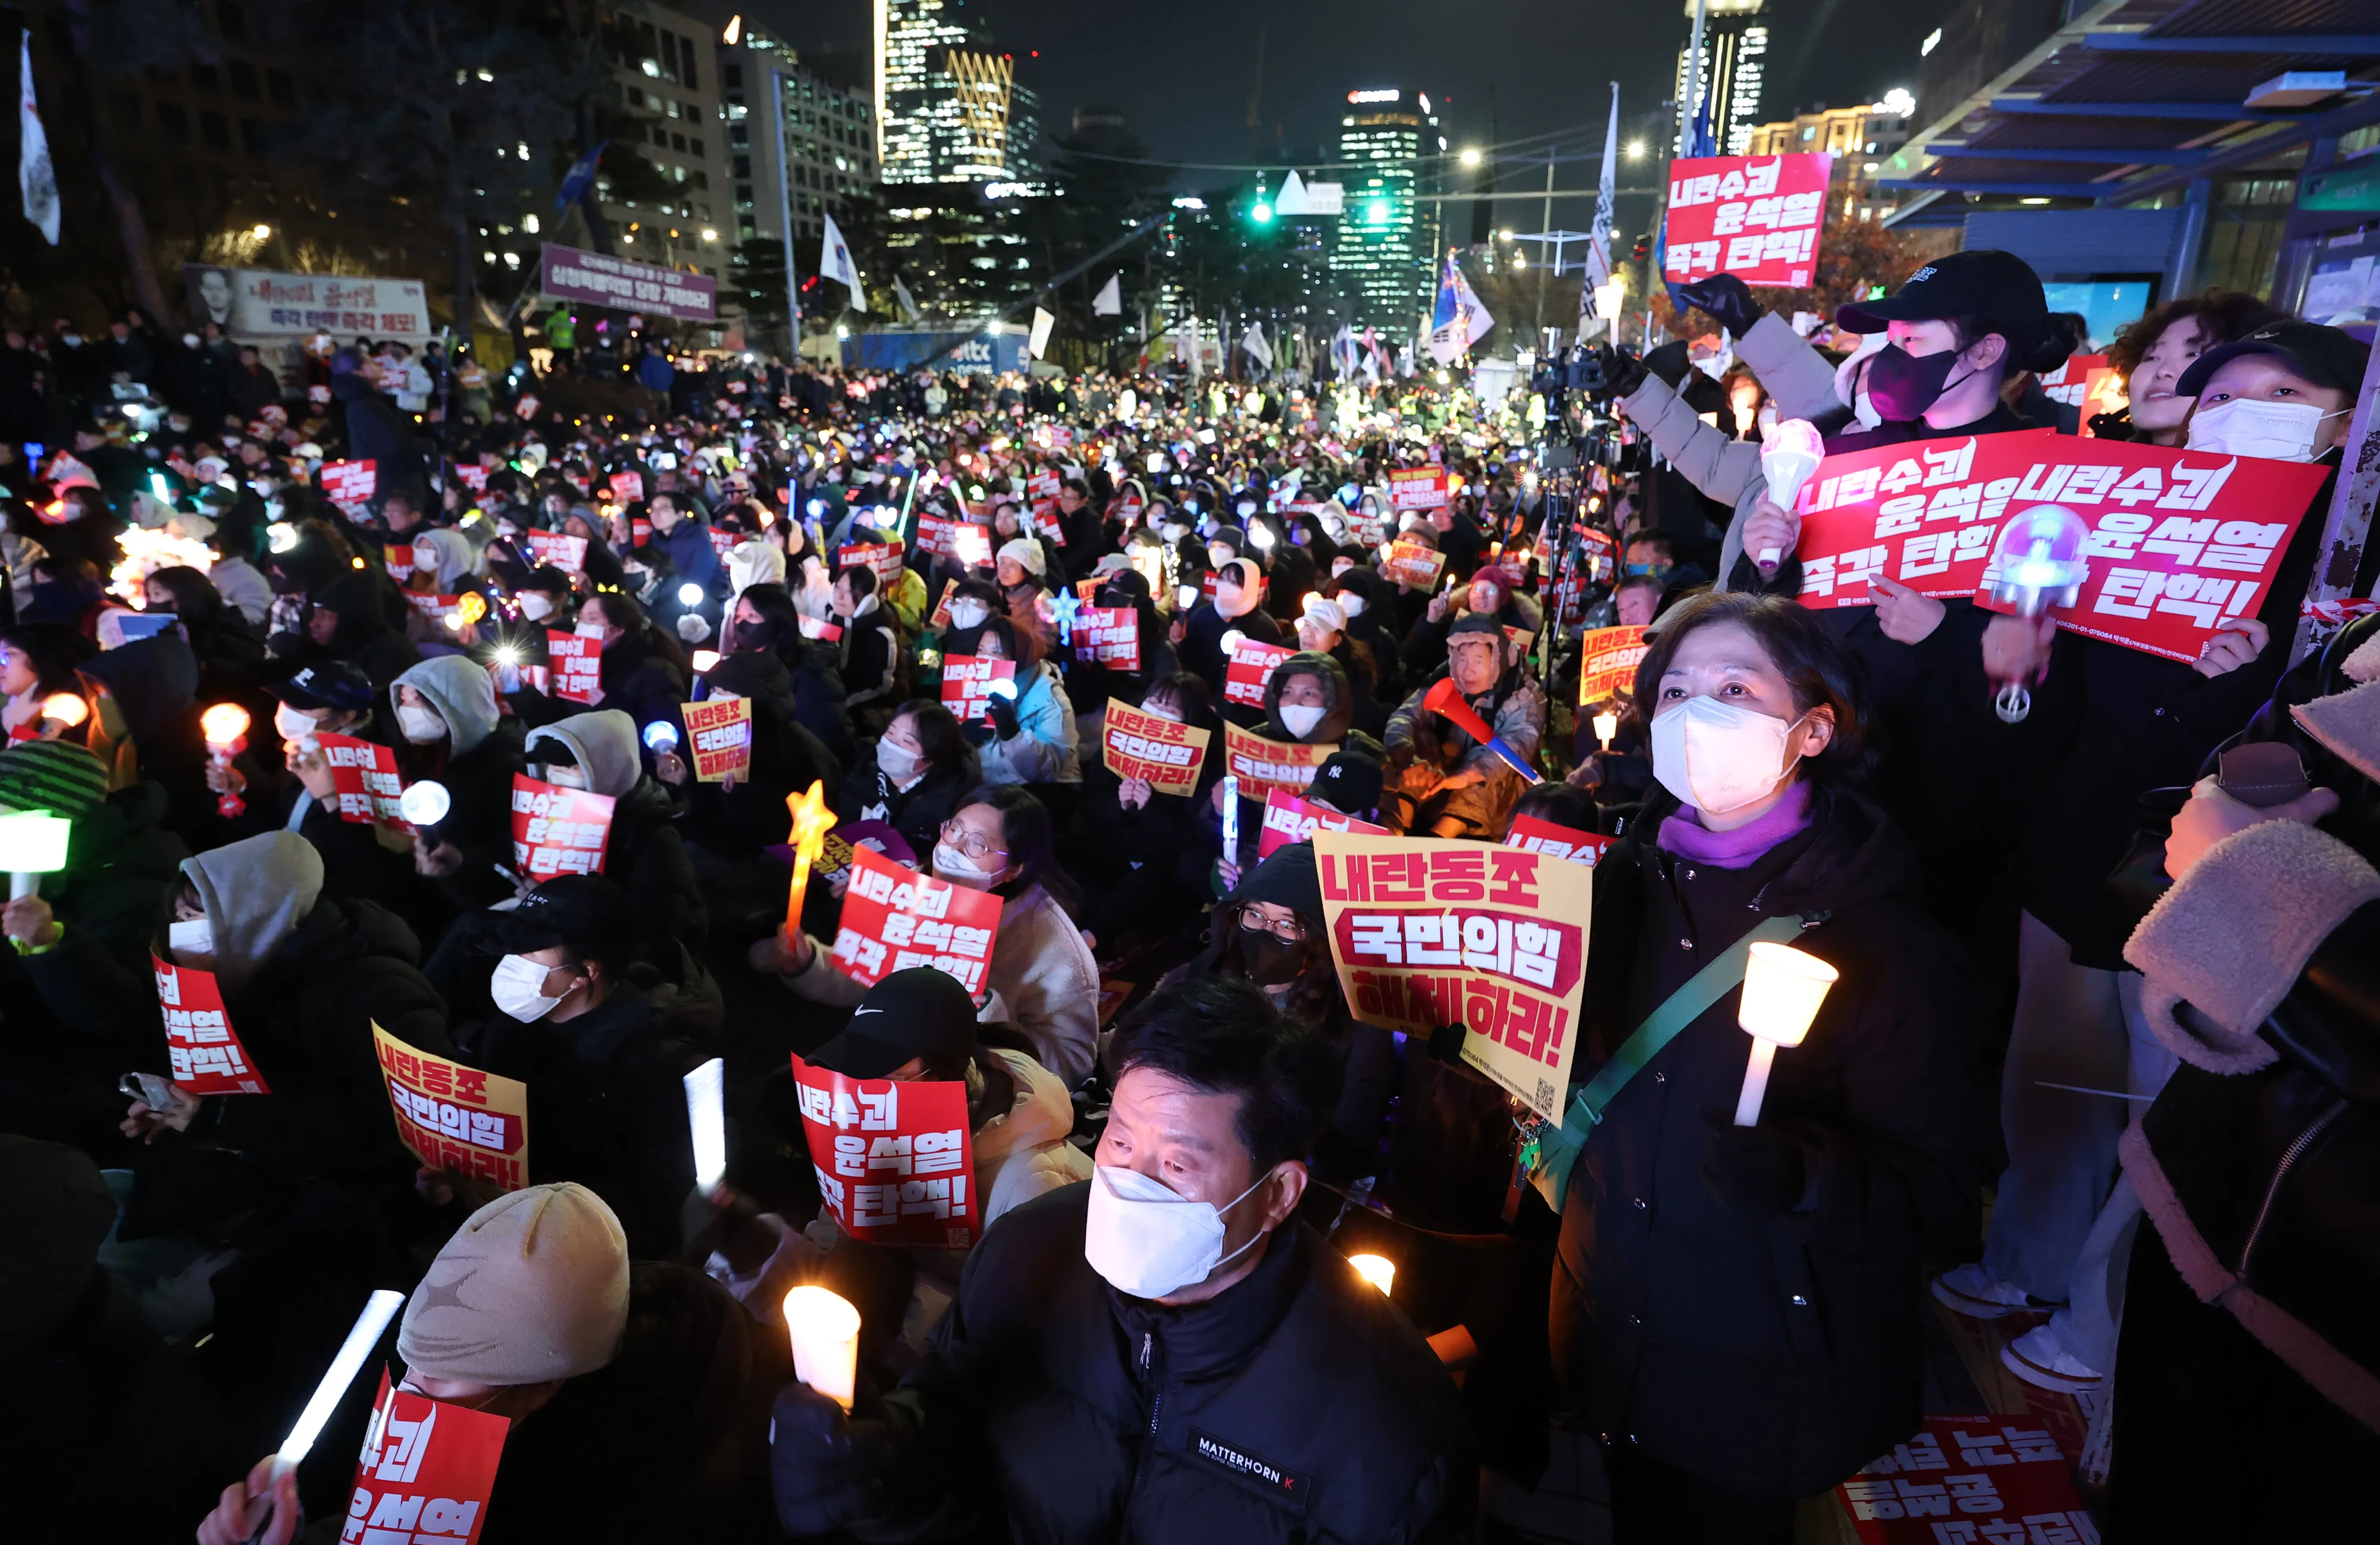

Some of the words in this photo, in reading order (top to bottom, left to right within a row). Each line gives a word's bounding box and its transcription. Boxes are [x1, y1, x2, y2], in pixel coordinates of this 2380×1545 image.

[1668, 155, 1781, 209] 내란수괴
[1712, 190, 1822, 236] 윤석열
[1666, 240, 1721, 274] 즉각
[1725, 228, 1817, 270] 탄핵!
[1797, 436, 1977, 516] 내란수괴
[2012, 456, 2237, 511] 내란수괴
[2090, 512, 2288, 573] 윤석열
[1802, 544, 1889, 597] 즉각
[2093, 566, 2260, 629] 탄핵!
[1230, 648, 1292, 668] 내란수
[1585, 627, 1648, 656] 내란동조
[1225, 681, 1266, 701] 즉각
[1585, 669, 1636, 698] 해체하
[686, 700, 741, 731] 내란동조
[696, 721, 747, 752] 국민의힘
[1107, 707, 1189, 742] 내란동조
[1107, 750, 1196, 785] 해체하라!
[1110, 730, 1194, 766] 국민의힘
[1328, 765, 1342, 779] NY
[340, 793, 375, 817] 즉각
[525, 817, 606, 849] 윤석열
[1508, 833, 1608, 869] 내란수
[529, 846, 602, 876] 탄핵!
[1321, 851, 1539, 909] 내란동조
[847, 864, 953, 919] 내란수괴
[833, 927, 888, 977] 즉각
[881, 912, 992, 958] 윤석열
[1351, 914, 1562, 989] 국민의힘
[1351, 970, 1570, 1069] 해체하라!
[169, 1045, 249, 1080] 탄핵!
[376, 1036, 487, 1105] 내란동조
[390, 1079, 505, 1151] 국민의힘
[796, 1080, 897, 1131] 내란수괴
[834, 1129, 962, 1177] 윤석열
[853, 1174, 967, 1227] 탄핵!
[1200, 1437, 1280, 1483] MATTERHORN
[1285, 1476, 1294, 1490] K
[1952, 1426, 2065, 1467] 즉각
[1843, 1473, 2005, 1521] 윤석열
